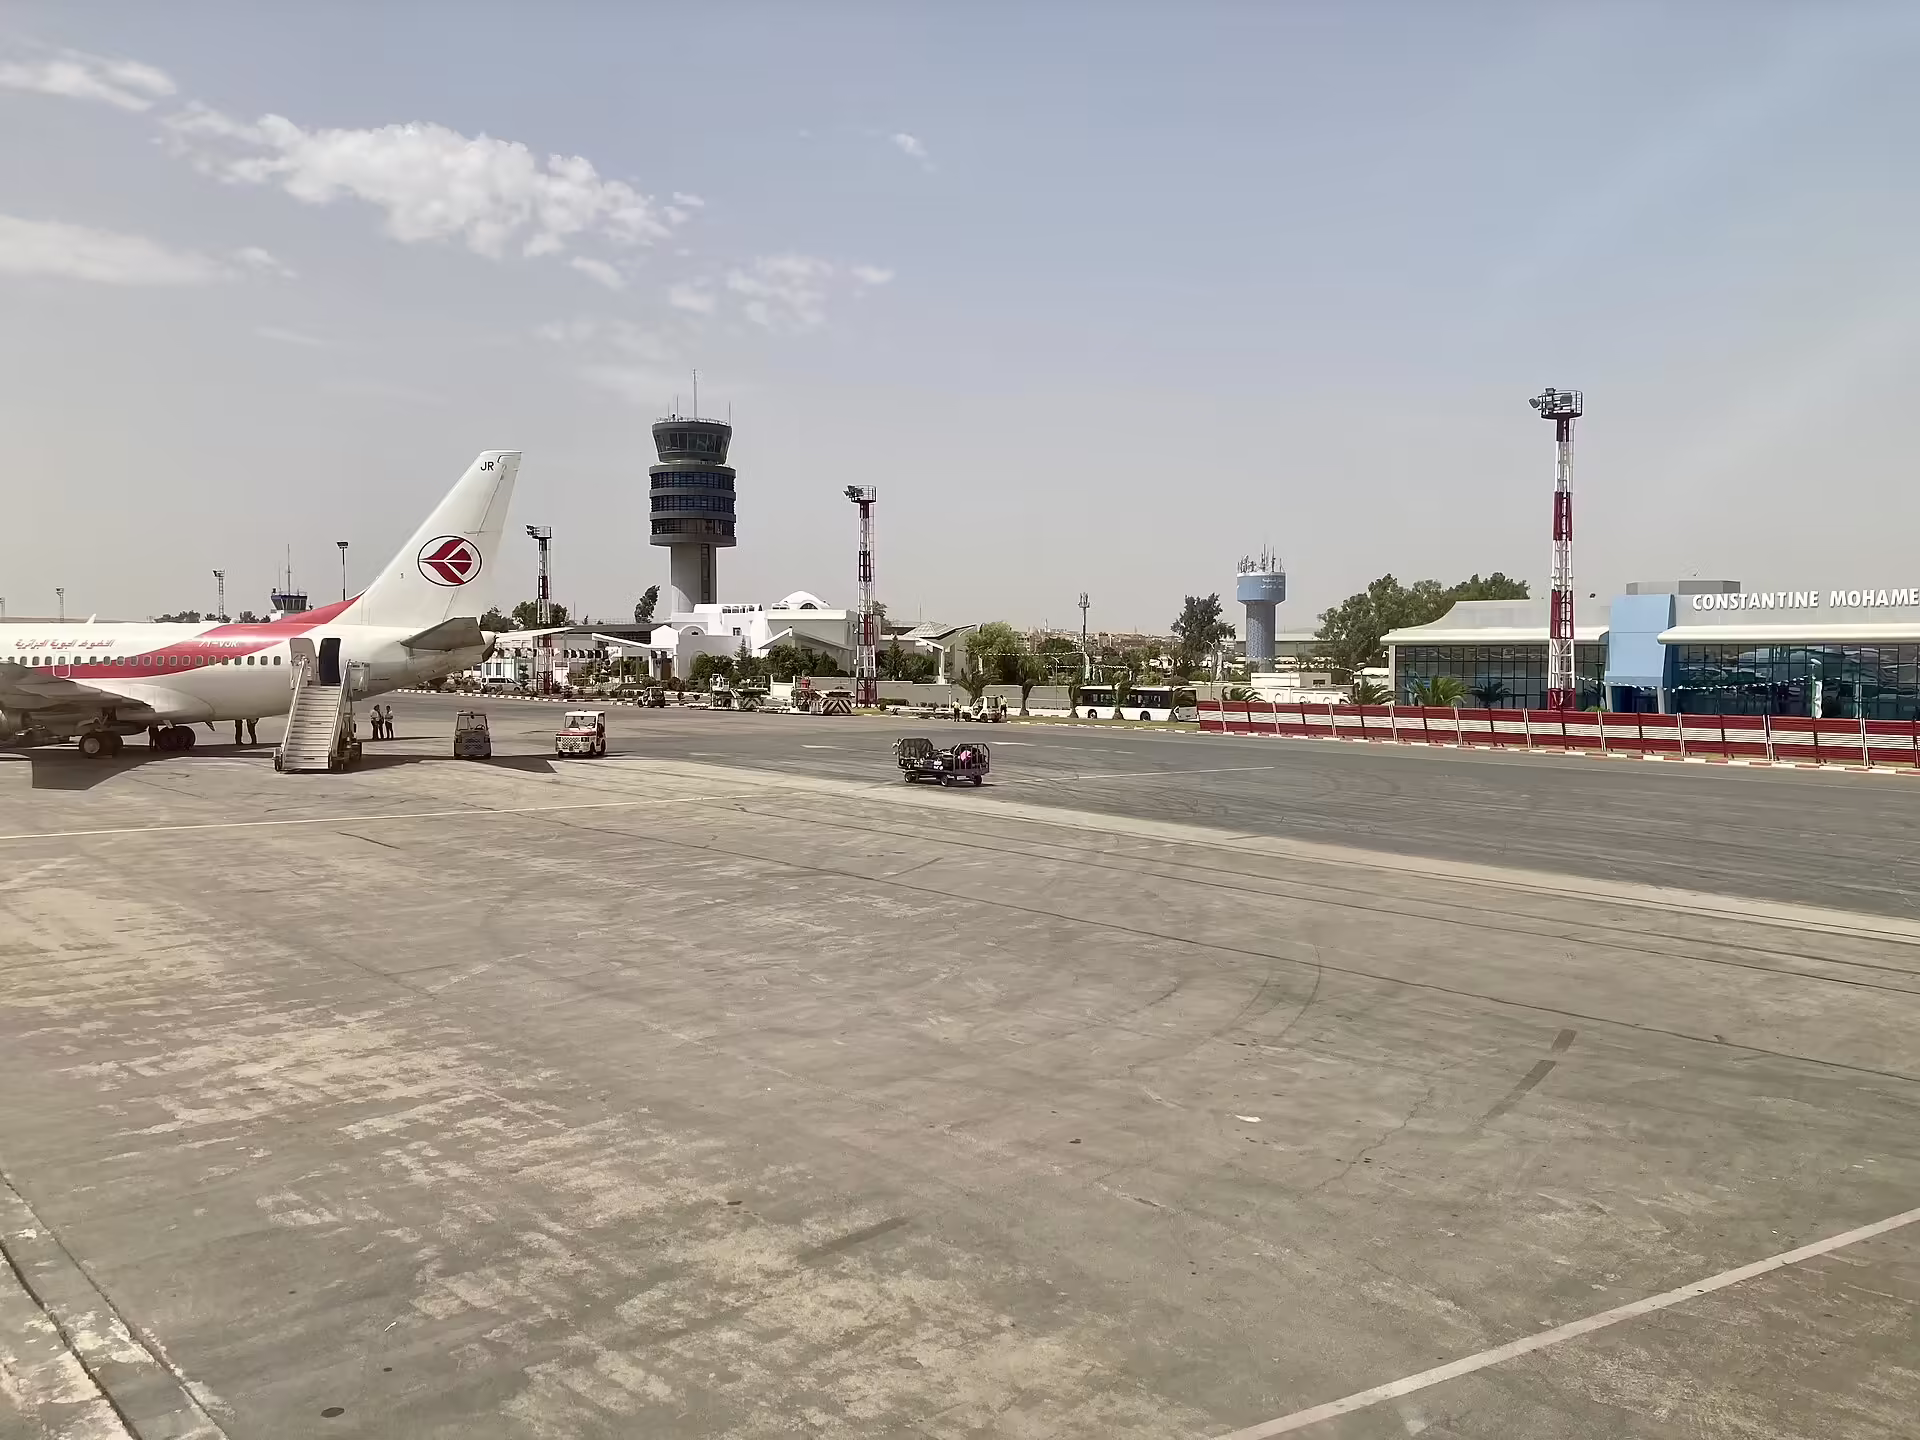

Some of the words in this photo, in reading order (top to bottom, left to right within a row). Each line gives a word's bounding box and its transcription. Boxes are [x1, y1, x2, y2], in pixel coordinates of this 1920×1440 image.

[480, 461, 494, 471] JR
[1692, 591, 1819, 610] CONSTANTINE
[1829, 588, 1919, 608] MOHAME
[50, 639, 78, 650] الجوية
[78, 639, 116, 650] الخطوط
